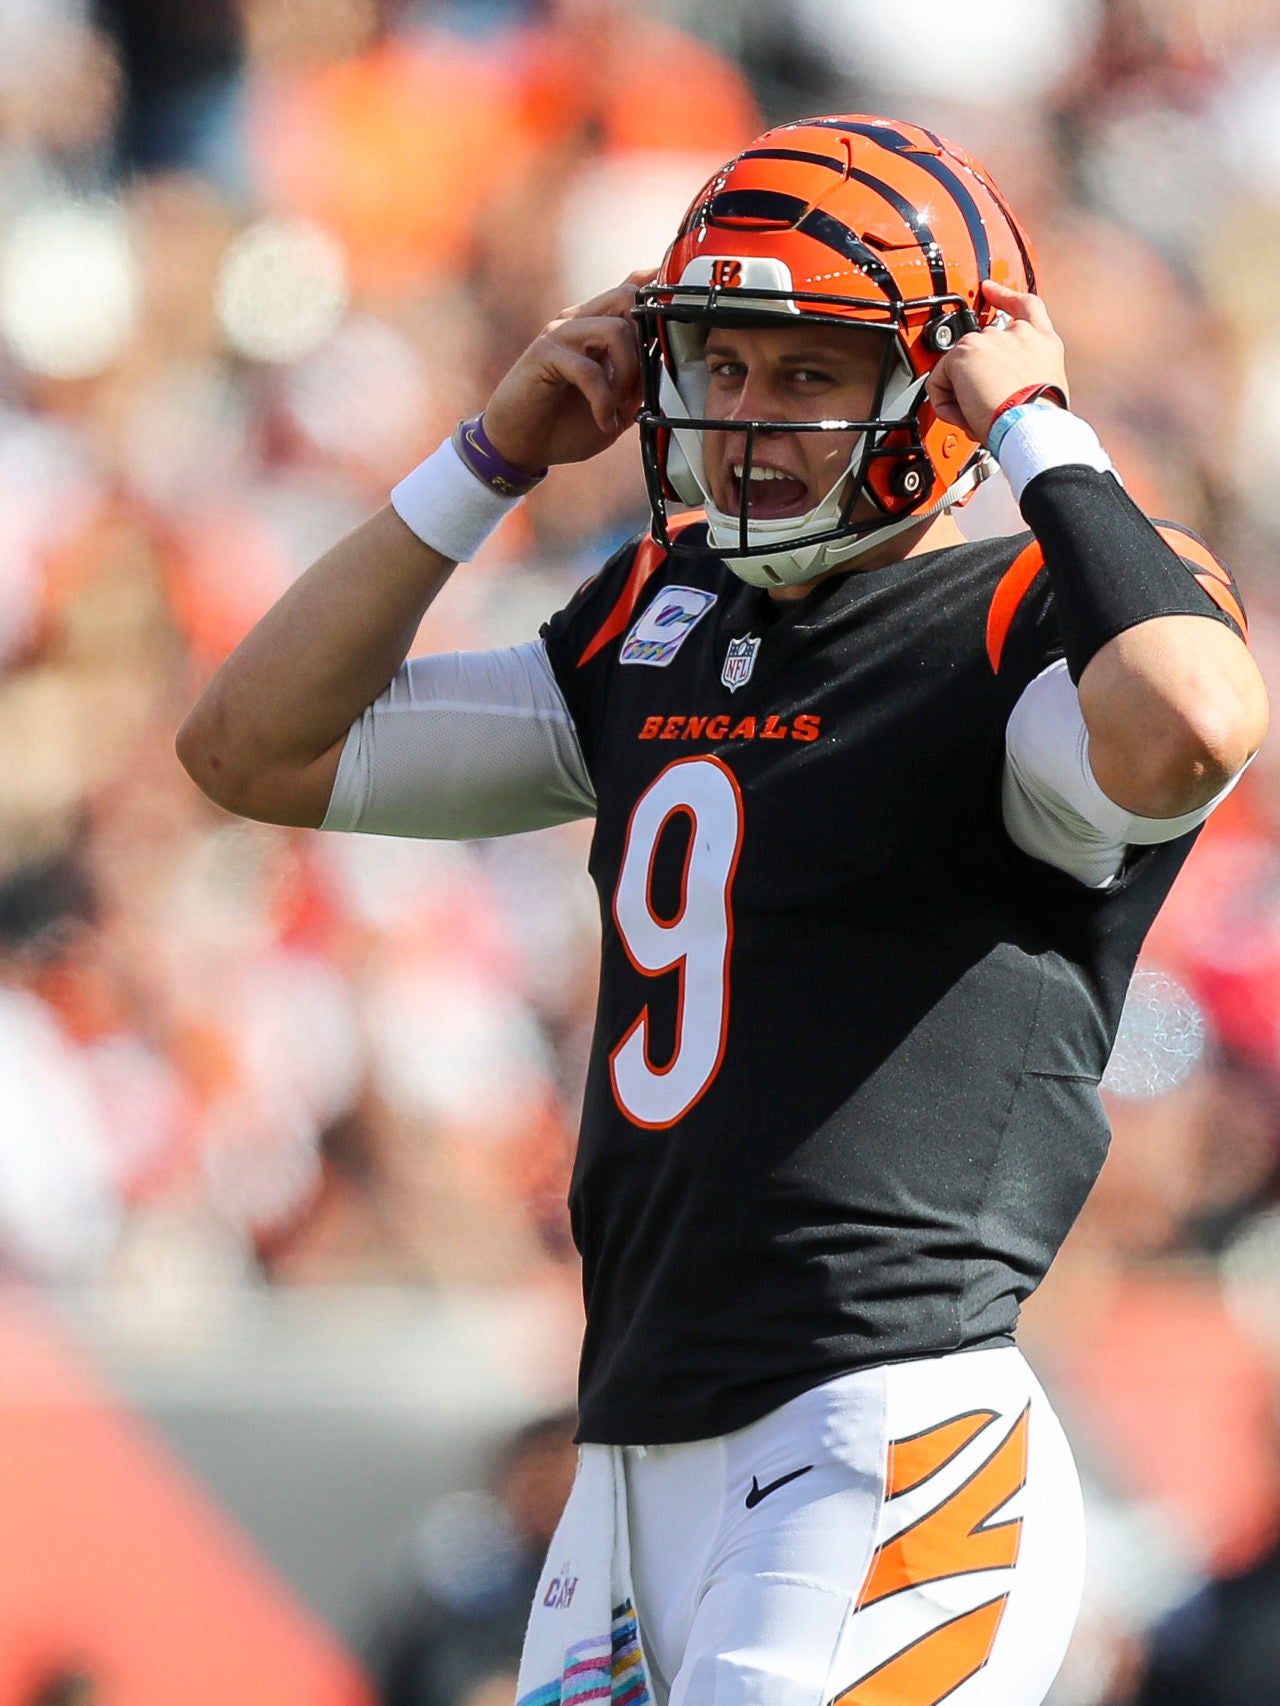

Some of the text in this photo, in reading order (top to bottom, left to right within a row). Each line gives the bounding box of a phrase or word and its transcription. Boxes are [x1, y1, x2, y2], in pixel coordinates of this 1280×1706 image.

[726, 658, 748, 681] NFL
[638, 715, 822, 741] BENGALS
[608, 754, 744, 1131] 9
